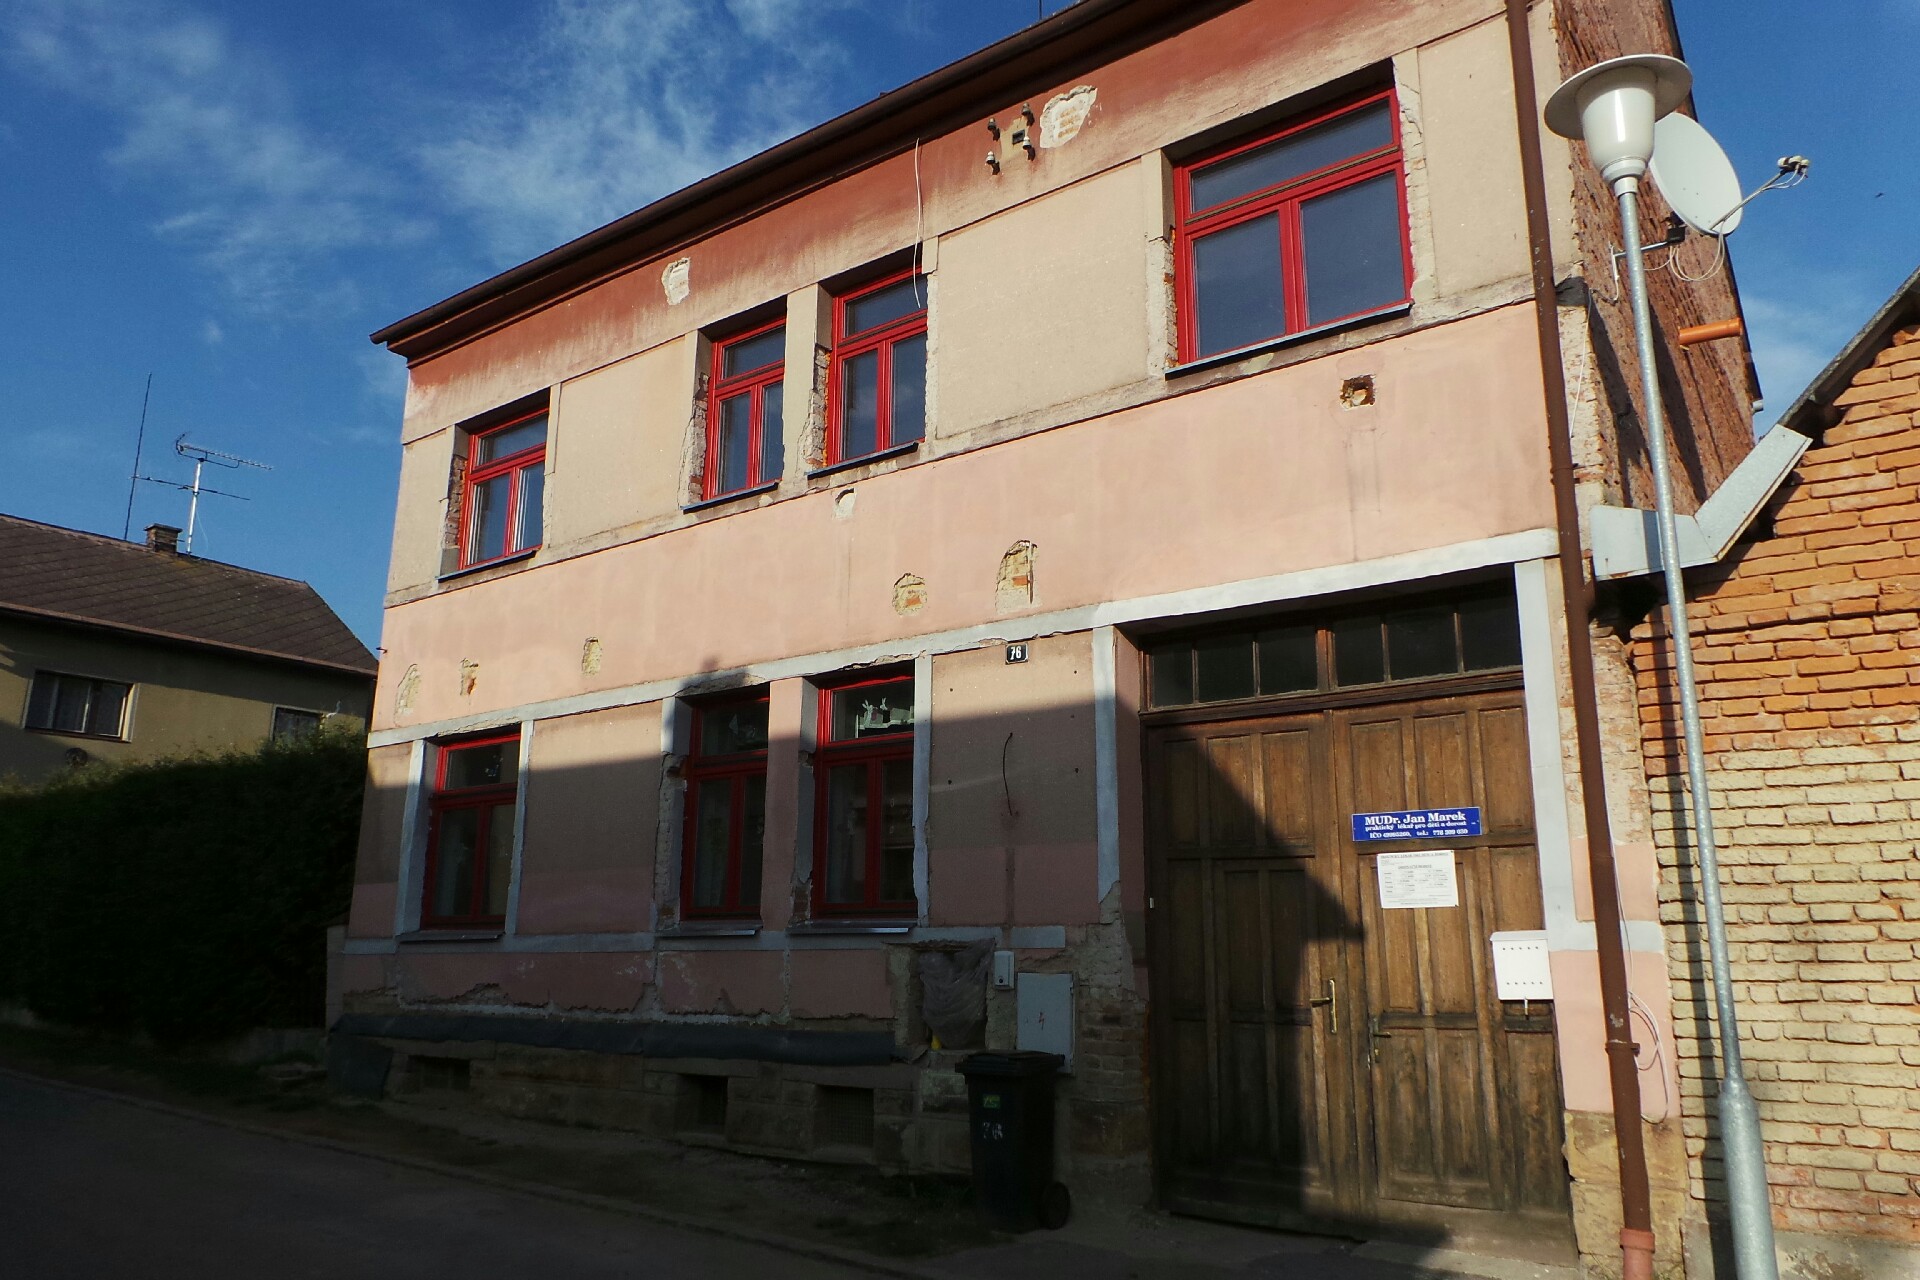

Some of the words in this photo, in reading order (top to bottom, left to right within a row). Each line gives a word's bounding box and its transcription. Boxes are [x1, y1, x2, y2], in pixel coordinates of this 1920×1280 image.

[1010, 645, 1022, 661] 76
[1364, 815, 1401, 826] MUDr.
[1403, 814, 1426, 824] Jan
[1427, 811, 1466, 822] Marek
